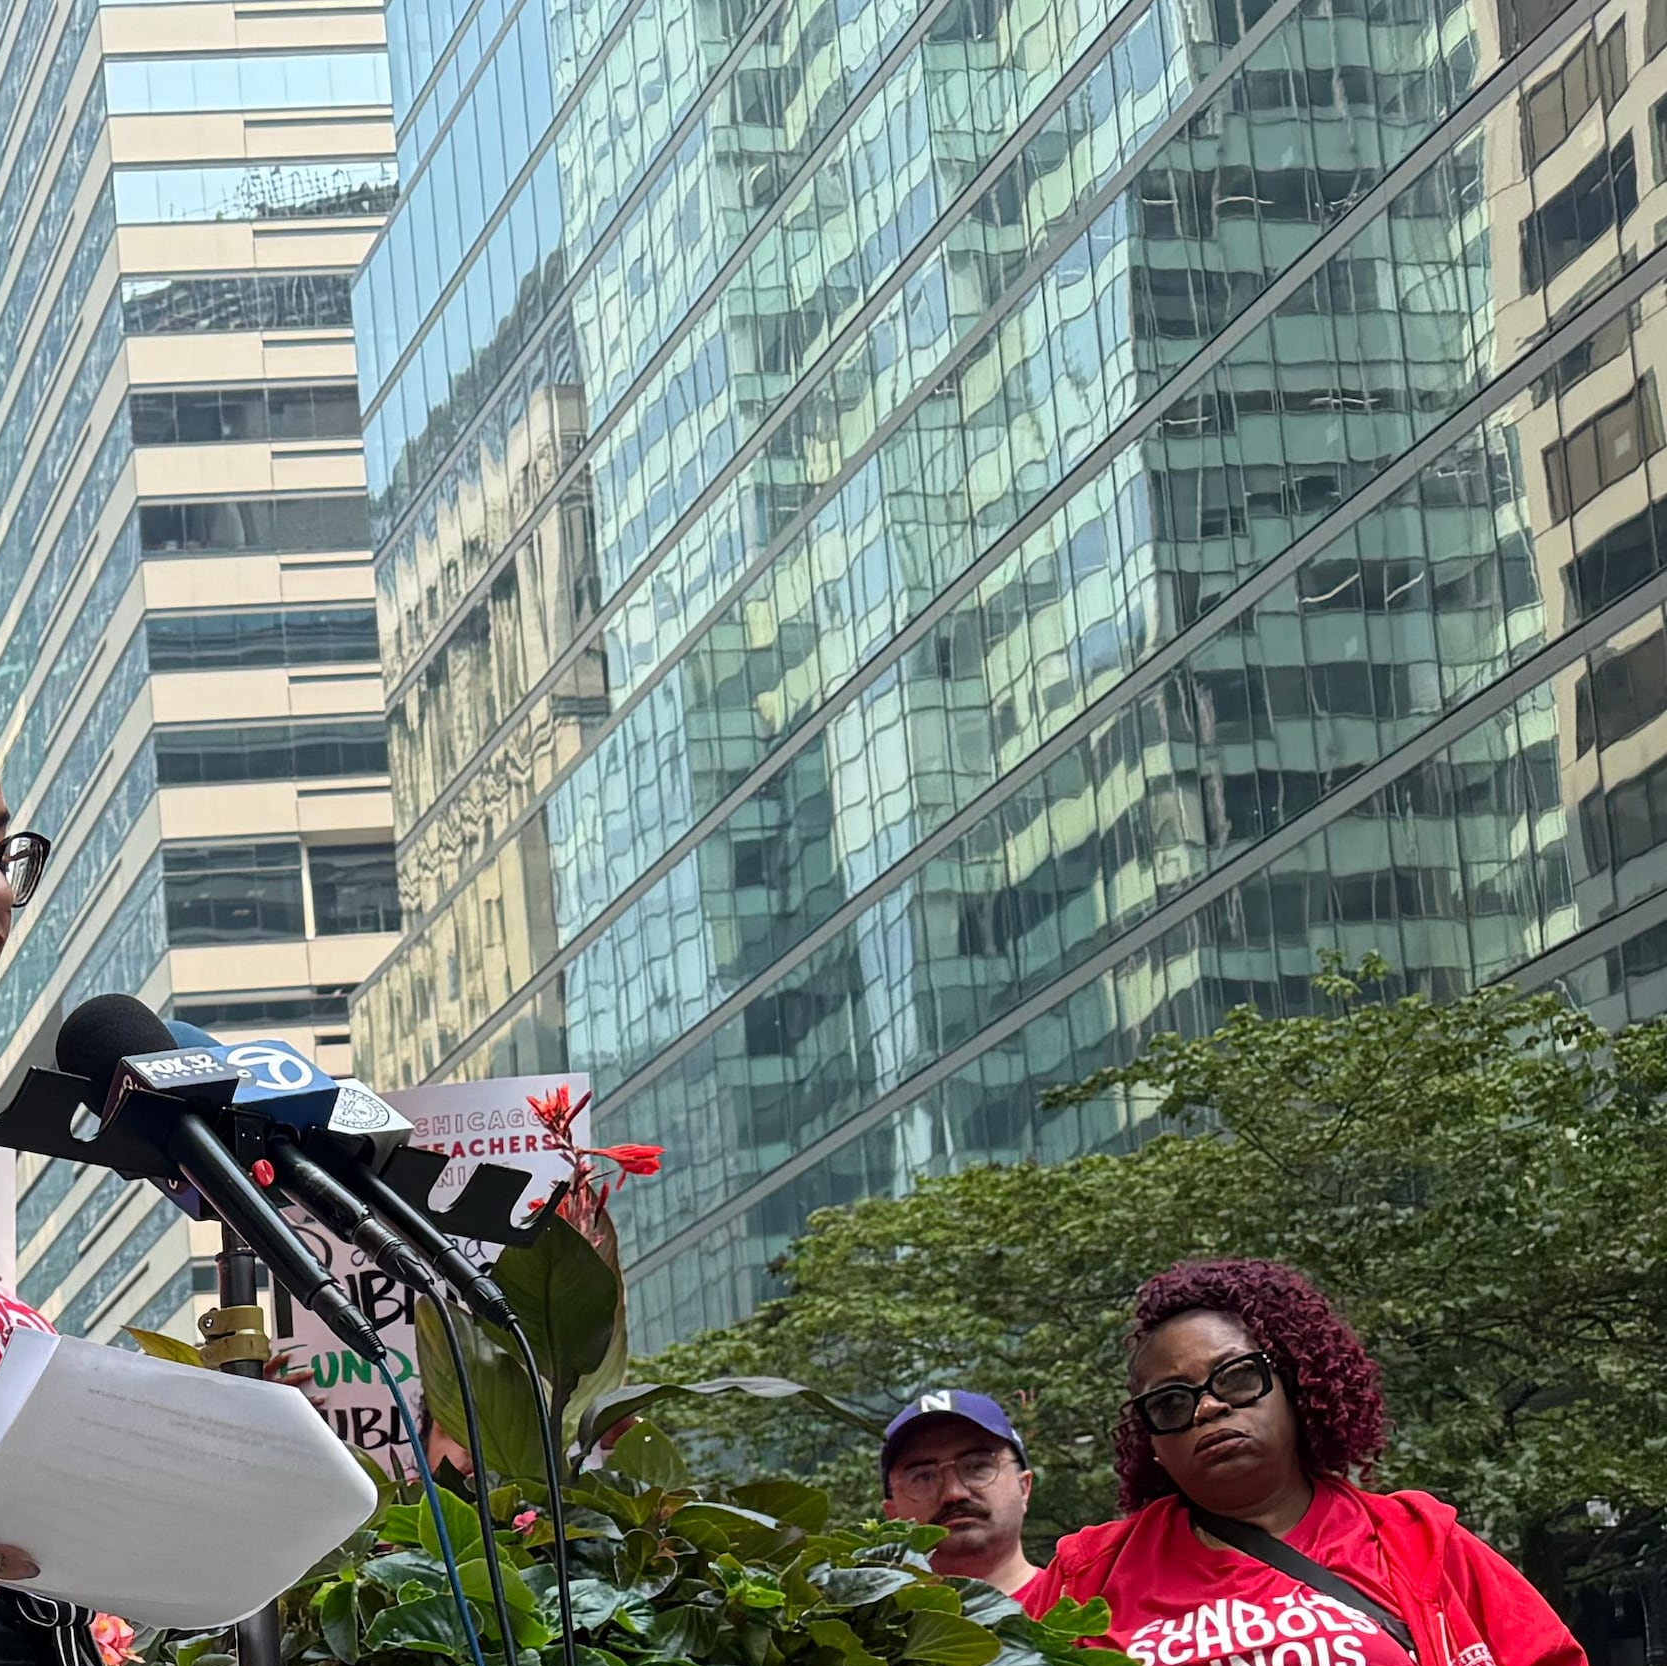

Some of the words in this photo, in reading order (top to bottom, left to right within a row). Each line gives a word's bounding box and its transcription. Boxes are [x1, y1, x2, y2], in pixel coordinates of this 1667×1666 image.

[135, 1056, 192, 1074] FOX
[412, 1109, 544, 1139] CHICAGO
[920, 1389, 953, 1413] N
[1130, 1597, 1269, 1641] FUND
